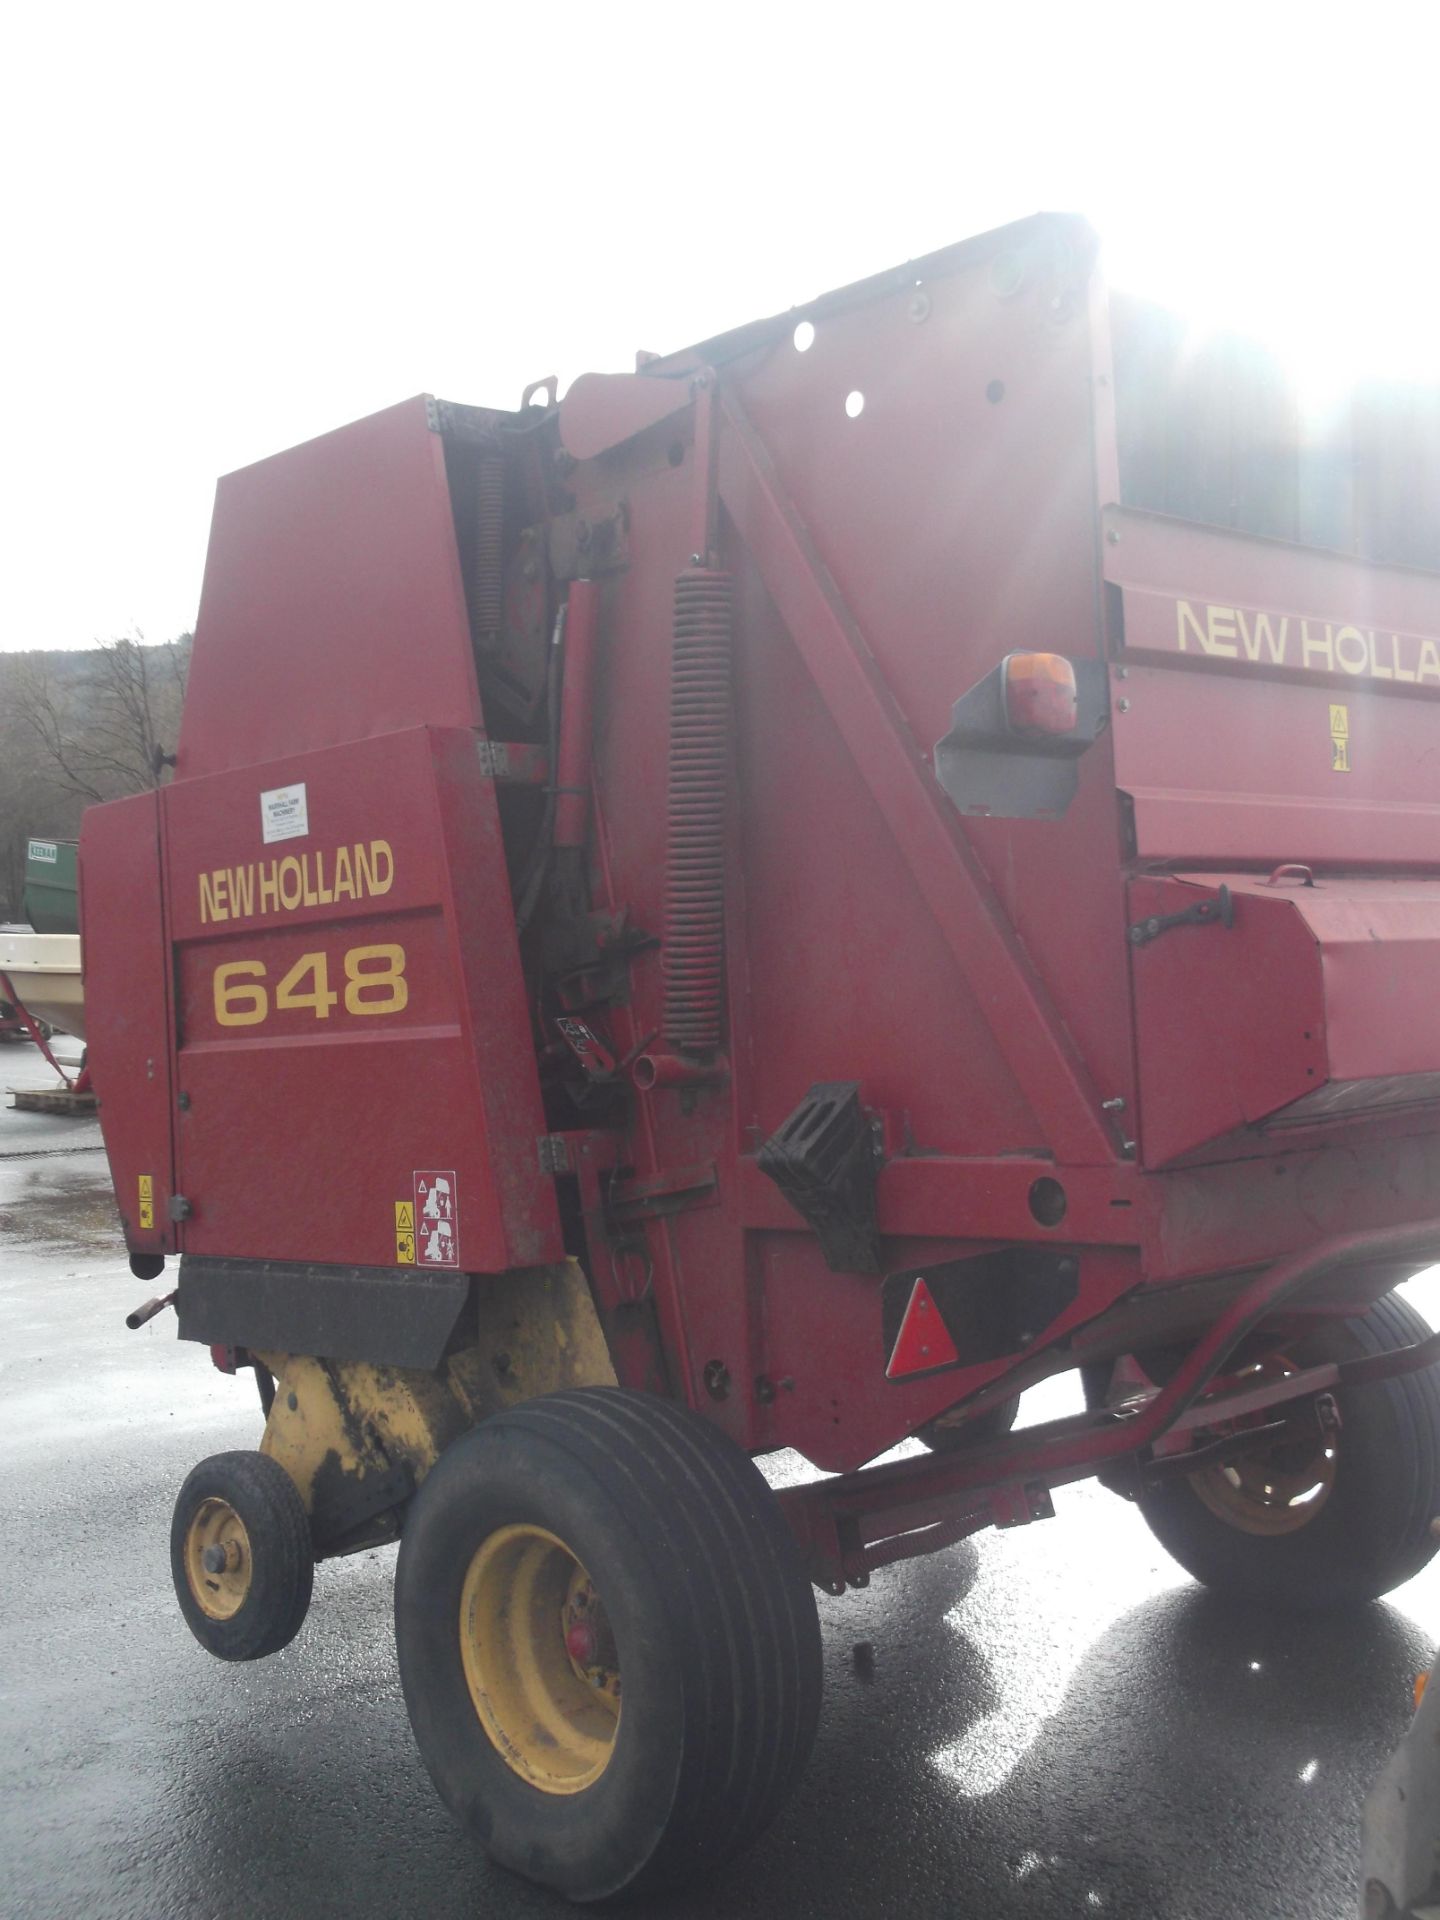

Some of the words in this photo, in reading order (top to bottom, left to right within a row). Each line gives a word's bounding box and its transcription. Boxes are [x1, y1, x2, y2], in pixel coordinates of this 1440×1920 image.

[1176, 600, 1288, 664] NEW
[199, 862, 254, 924] NEW
[259, 840, 394, 914] HOLLAND
[213, 943, 408, 1026] 648
